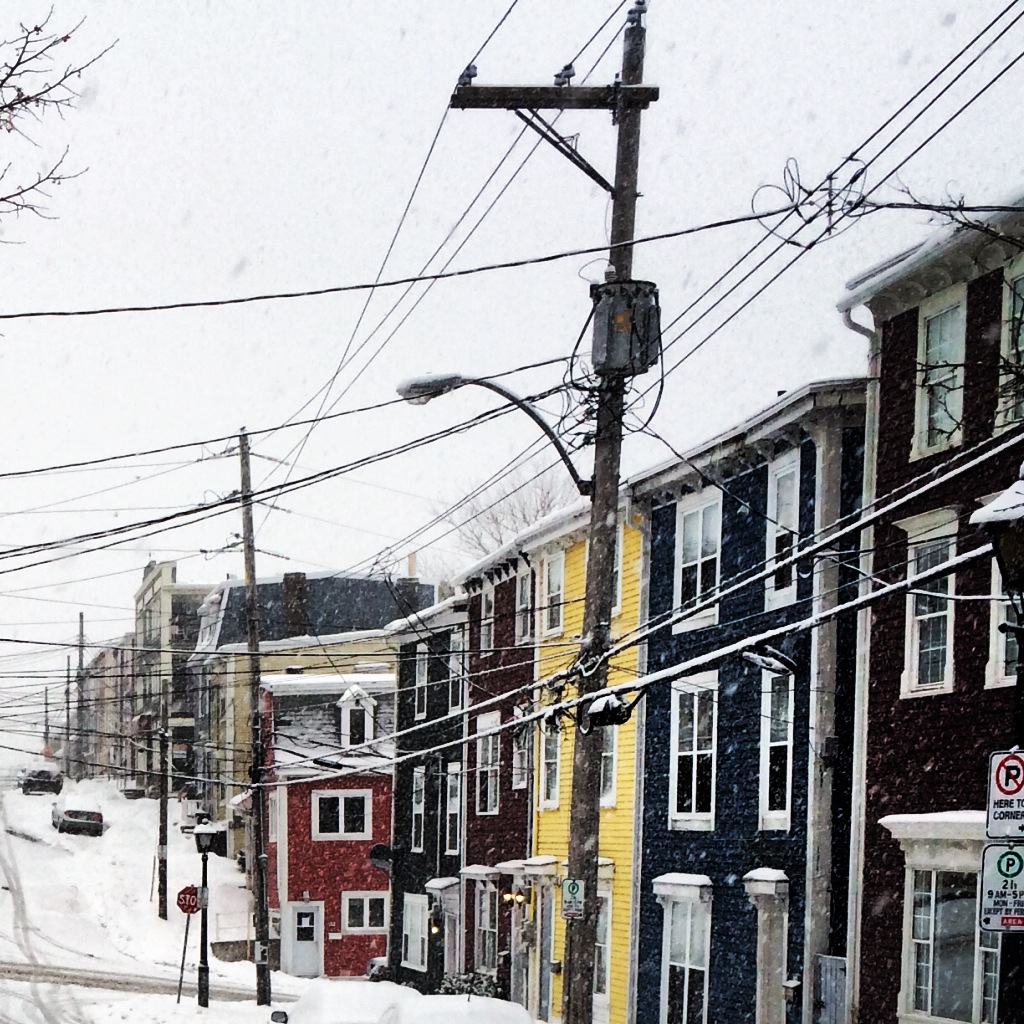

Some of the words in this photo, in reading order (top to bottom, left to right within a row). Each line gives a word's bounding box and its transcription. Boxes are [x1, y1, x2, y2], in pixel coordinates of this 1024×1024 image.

[1005, 765, 1021, 787] P
[993, 799, 1015, 808] HERE
[993, 811, 1024, 820] CORNER
[1006, 858, 1016, 872] P
[178, 894, 197, 906] STO
